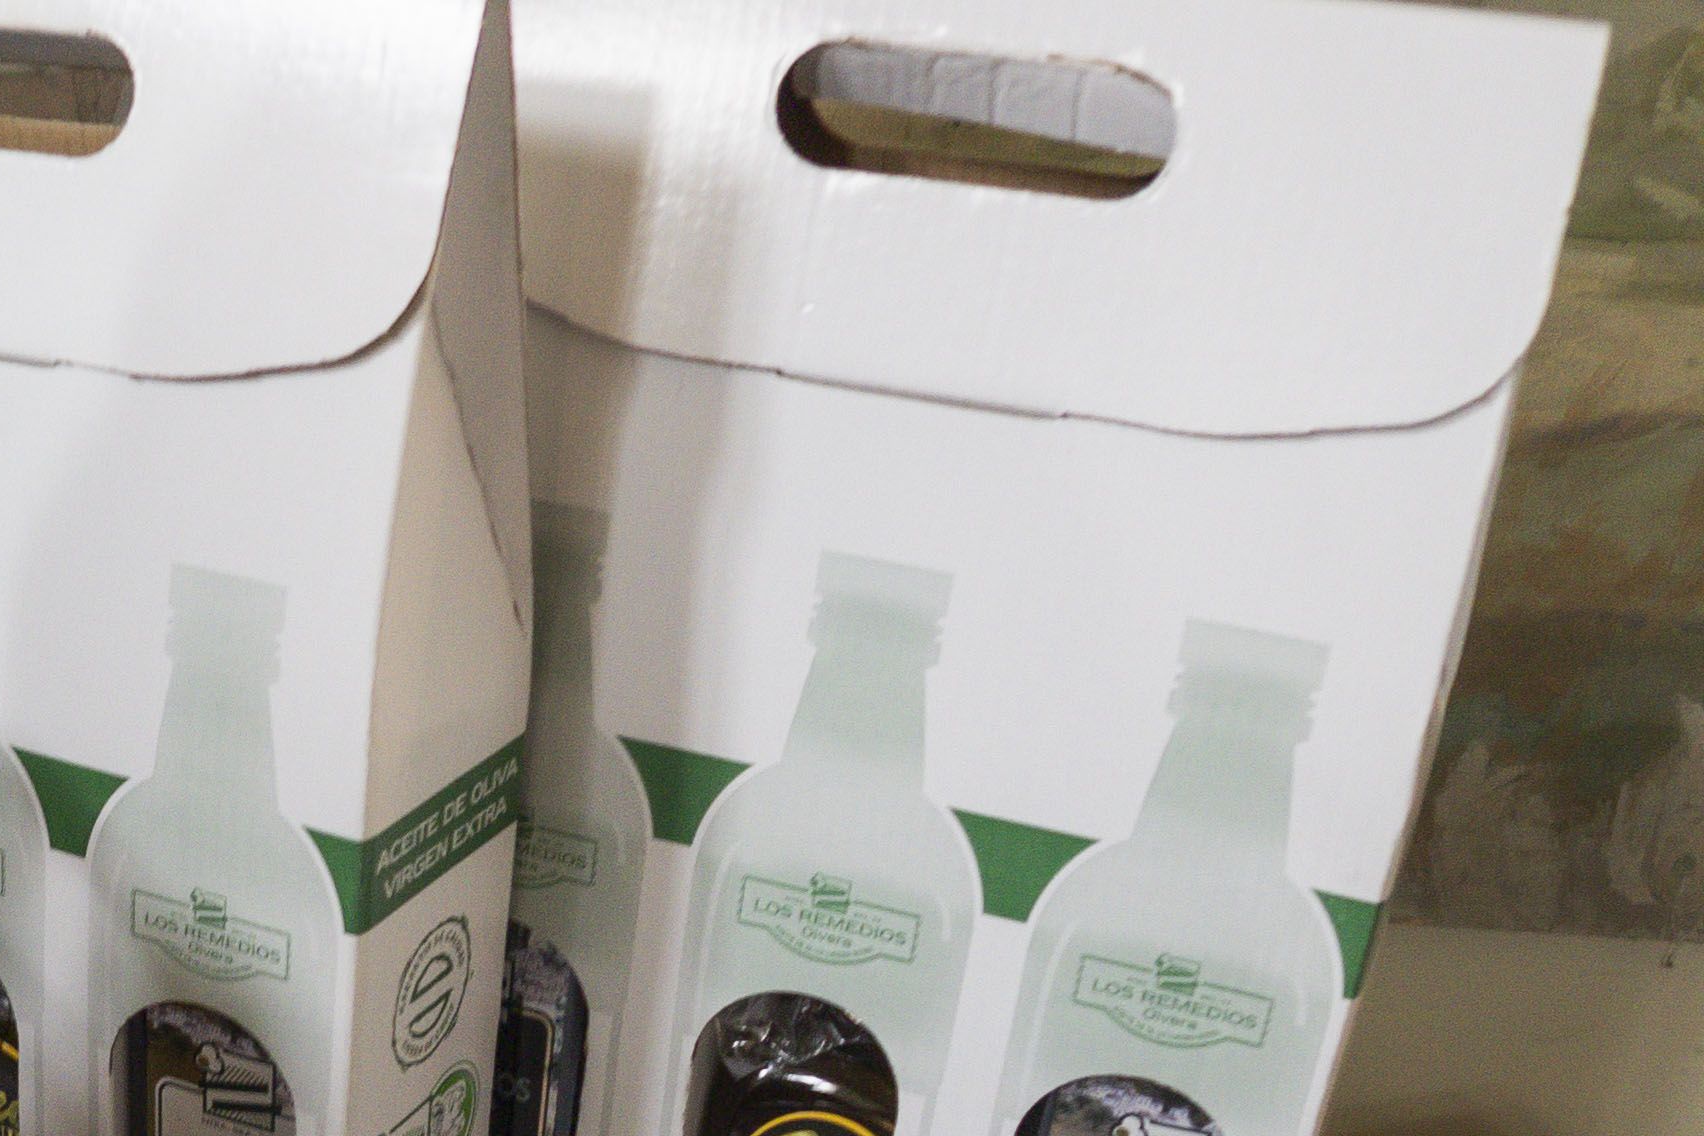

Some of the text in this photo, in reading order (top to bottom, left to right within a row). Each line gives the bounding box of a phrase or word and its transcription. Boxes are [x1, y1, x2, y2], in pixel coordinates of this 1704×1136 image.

[376, 757, 518, 876] ACEITE DE OLIVA
[453, 797, 508, 849] EXTRA
[754, 898, 793, 918] LOS
[799, 909, 907, 945] REMEDIOS
[1092, 978, 1134, 999] LOS
[1141, 990, 1257, 1029] REMEDIOS
